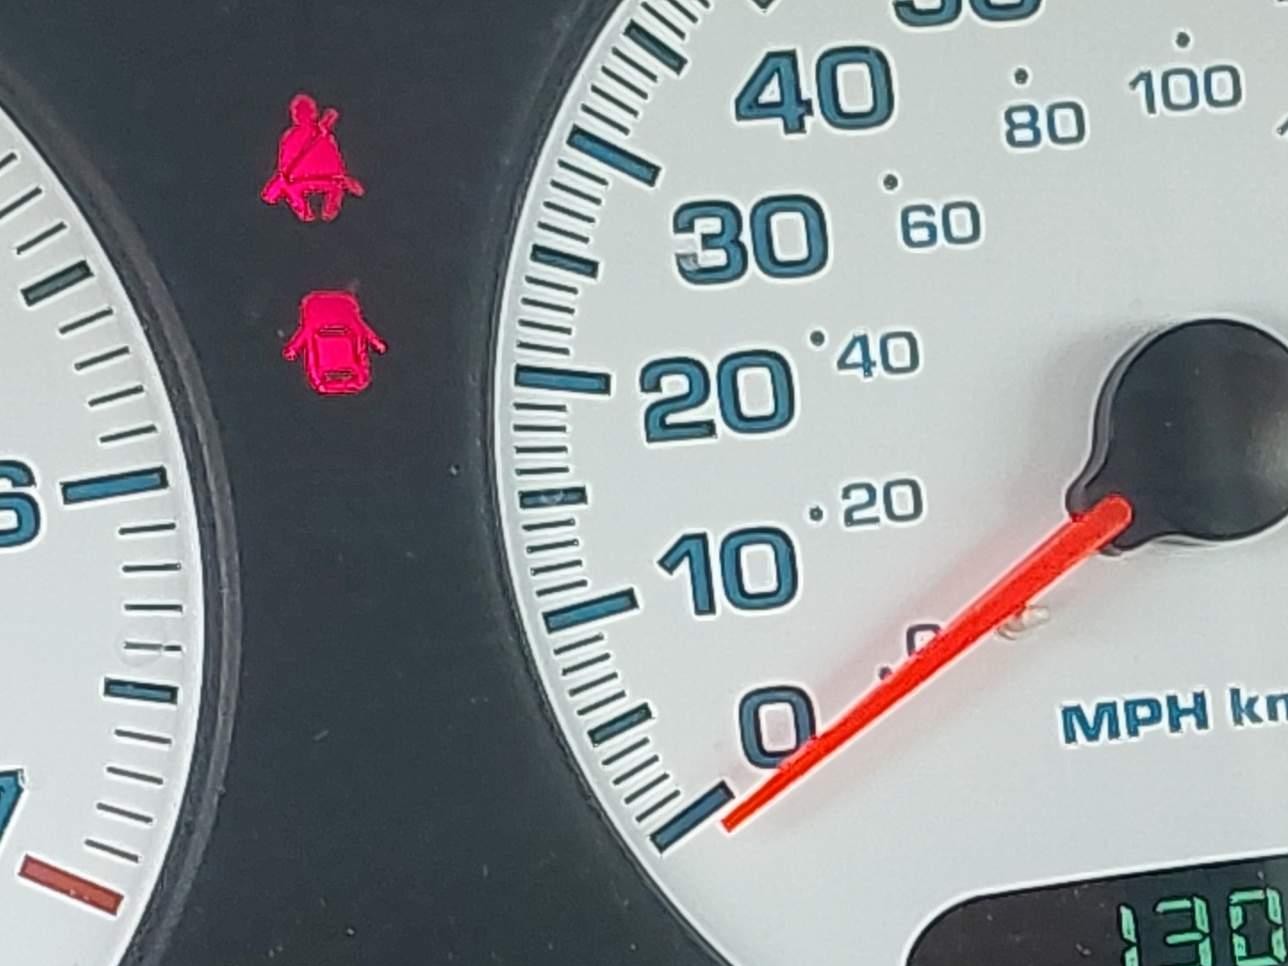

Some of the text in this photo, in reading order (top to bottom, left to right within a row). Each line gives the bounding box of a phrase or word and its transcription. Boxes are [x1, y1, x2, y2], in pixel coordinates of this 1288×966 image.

[735, 46, 894, 134] 40
[1129, 65, 1241, 113] 100
[1004, 101, 1086, 148] 80
[673, 194, 828, 285] 30
[901, 201, 980, 248] 60
[836, 331, 919, 378] 40
[639, 349, 795, 443] 20
[841, 479, 922, 527] 20
[657, 526, 798, 615] 10
[739, 685, 817, 769] 0
[1062, 691, 1208, 745] MPH
